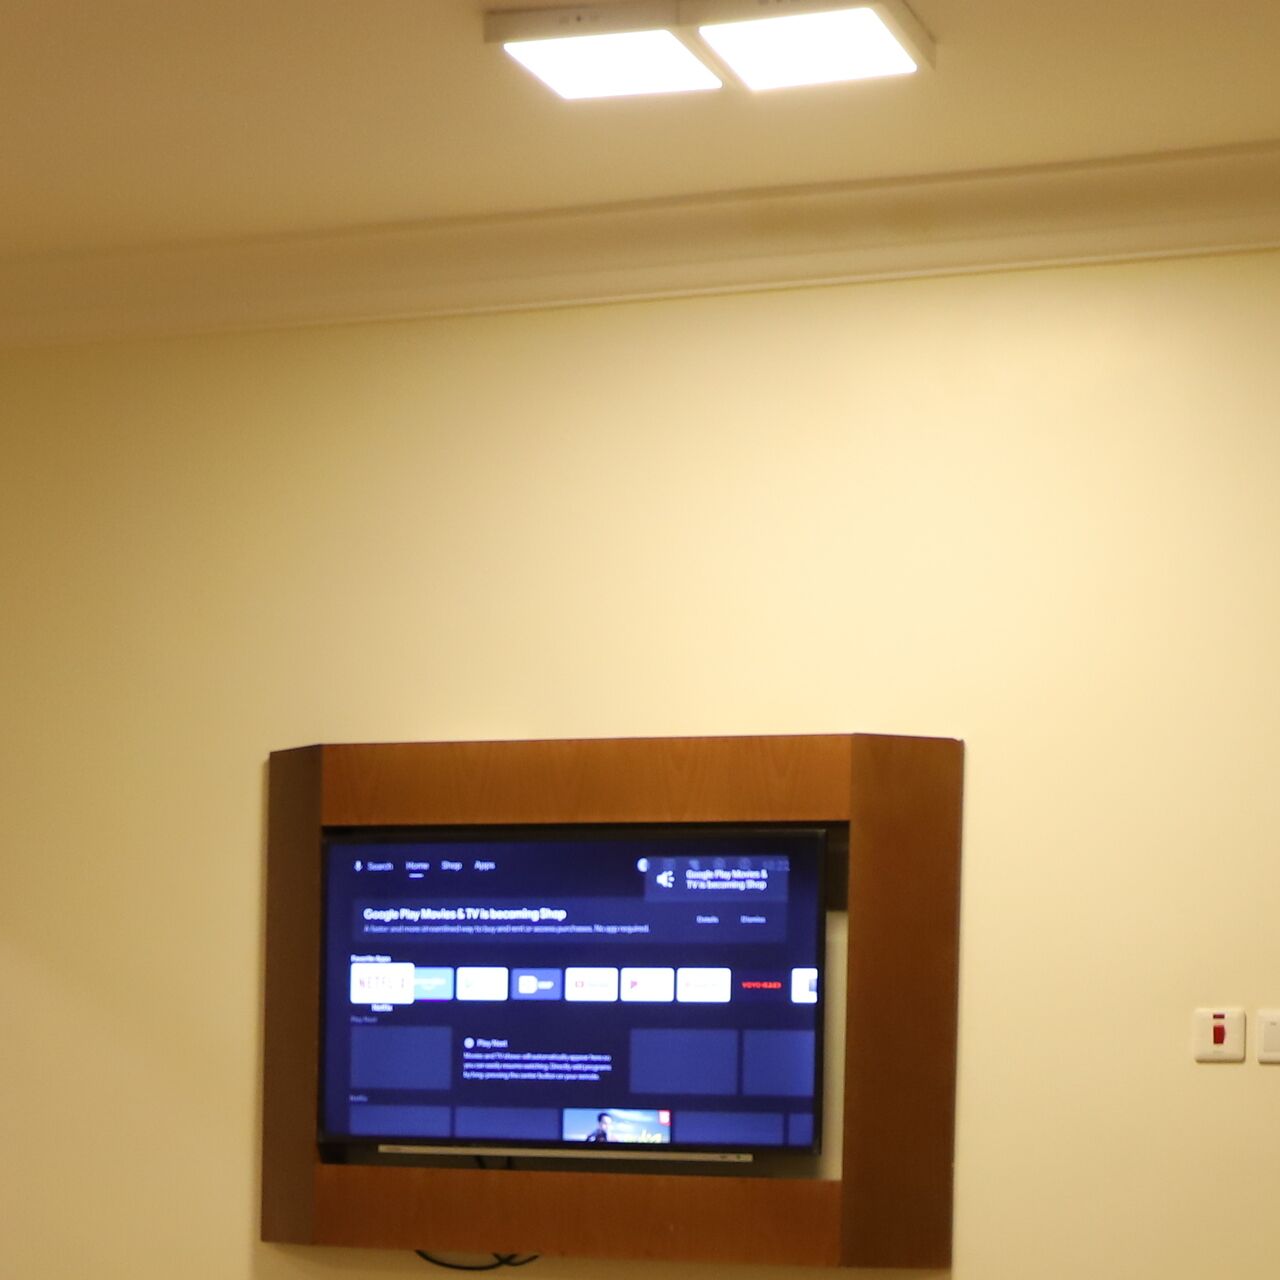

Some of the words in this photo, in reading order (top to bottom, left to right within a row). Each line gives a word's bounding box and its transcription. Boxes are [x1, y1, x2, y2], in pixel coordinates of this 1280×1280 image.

[367, 862, 394, 871] Search
[405, 862, 430, 870] Home
[441, 861, 463, 870] Shop
[474, 861, 496, 870] Apps
[686, 870, 714, 879] Google
[715, 870, 731, 879] Play
[732, 870, 760, 878] Movies
[707, 880, 745, 890] becoming
[746, 880, 767, 889] Shop
[363, 909, 398, 921] Google
[400, 909, 420, 920] Play
[421, 909, 455, 919] Movies
[457, 908, 465, 919] &
[466, 908, 480, 919] TV
[482, 909, 490, 919] is
[492, 909, 539, 921] becoming
[541, 908, 566, 920] Shop
[477, 1039, 491, 1048] Play
[492, 1039, 508, 1048] Next
